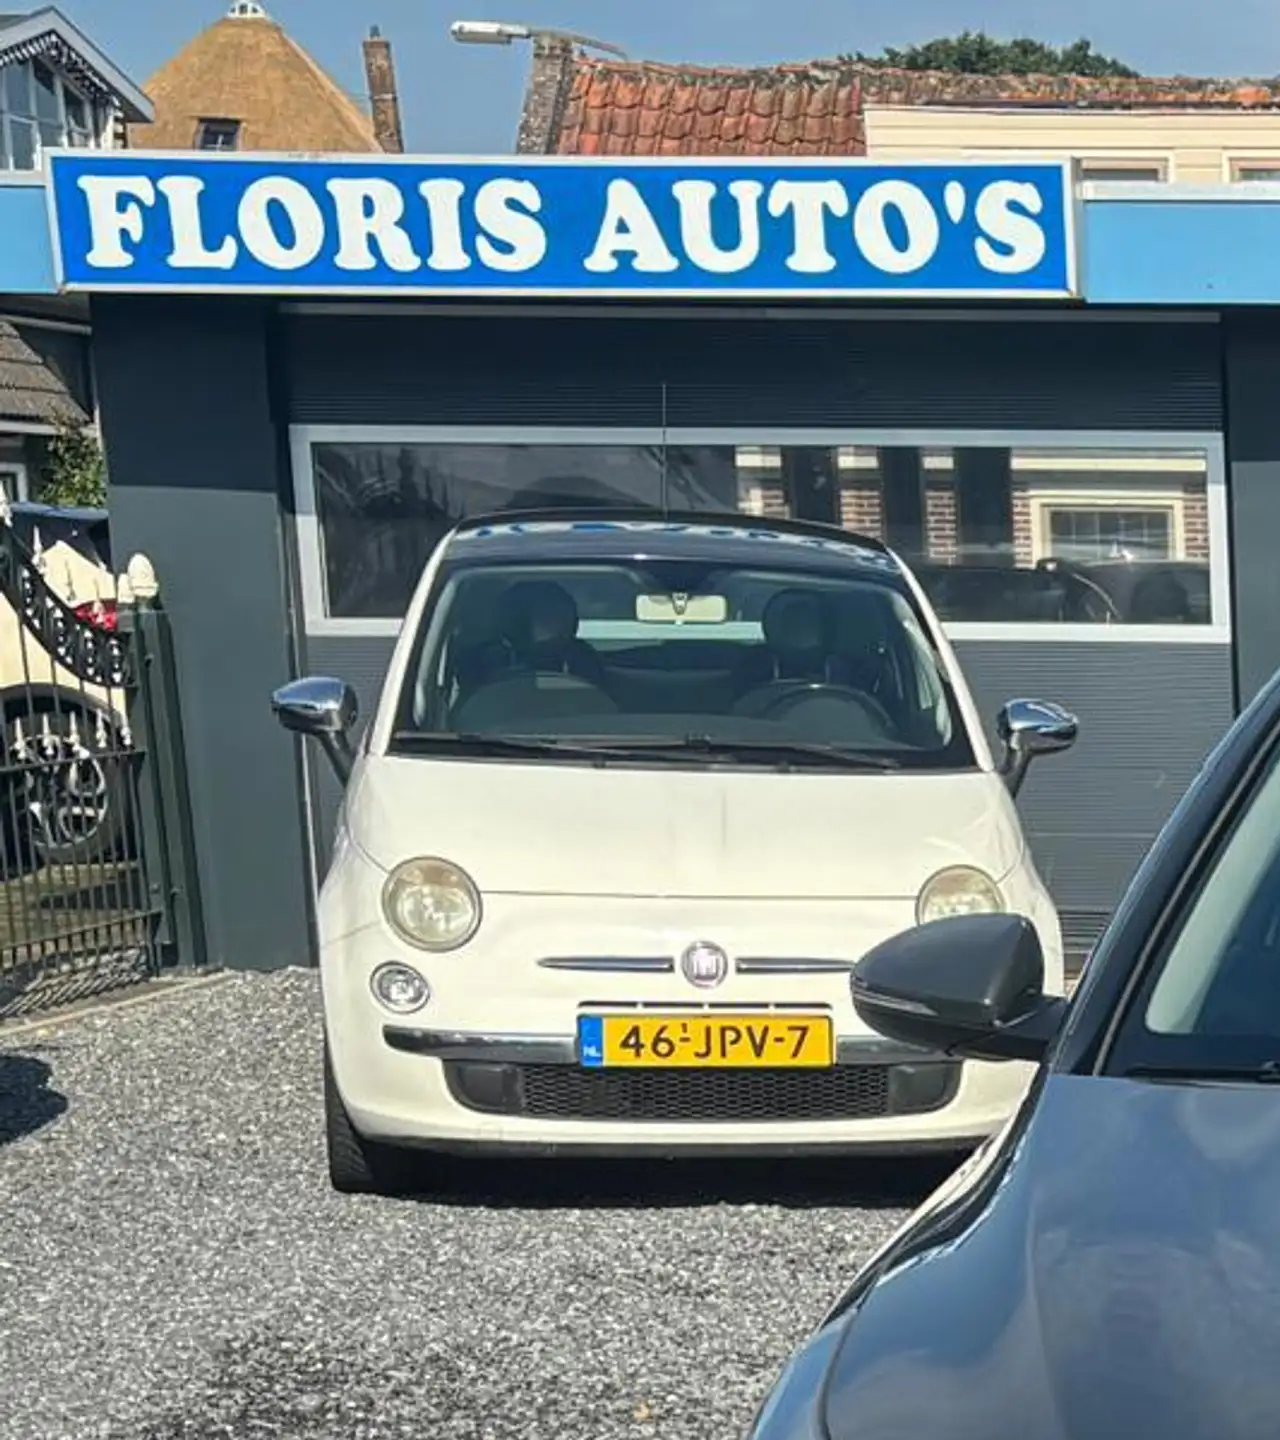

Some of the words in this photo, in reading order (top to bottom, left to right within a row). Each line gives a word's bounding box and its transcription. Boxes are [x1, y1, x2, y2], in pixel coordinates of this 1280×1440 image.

[77, 175, 547, 272] FLORIS
[583, 179, 1047, 274] AUTO'S
[583, 1045, 602, 1058] NL
[618, 1024, 811, 1059] 46-JPV-7
